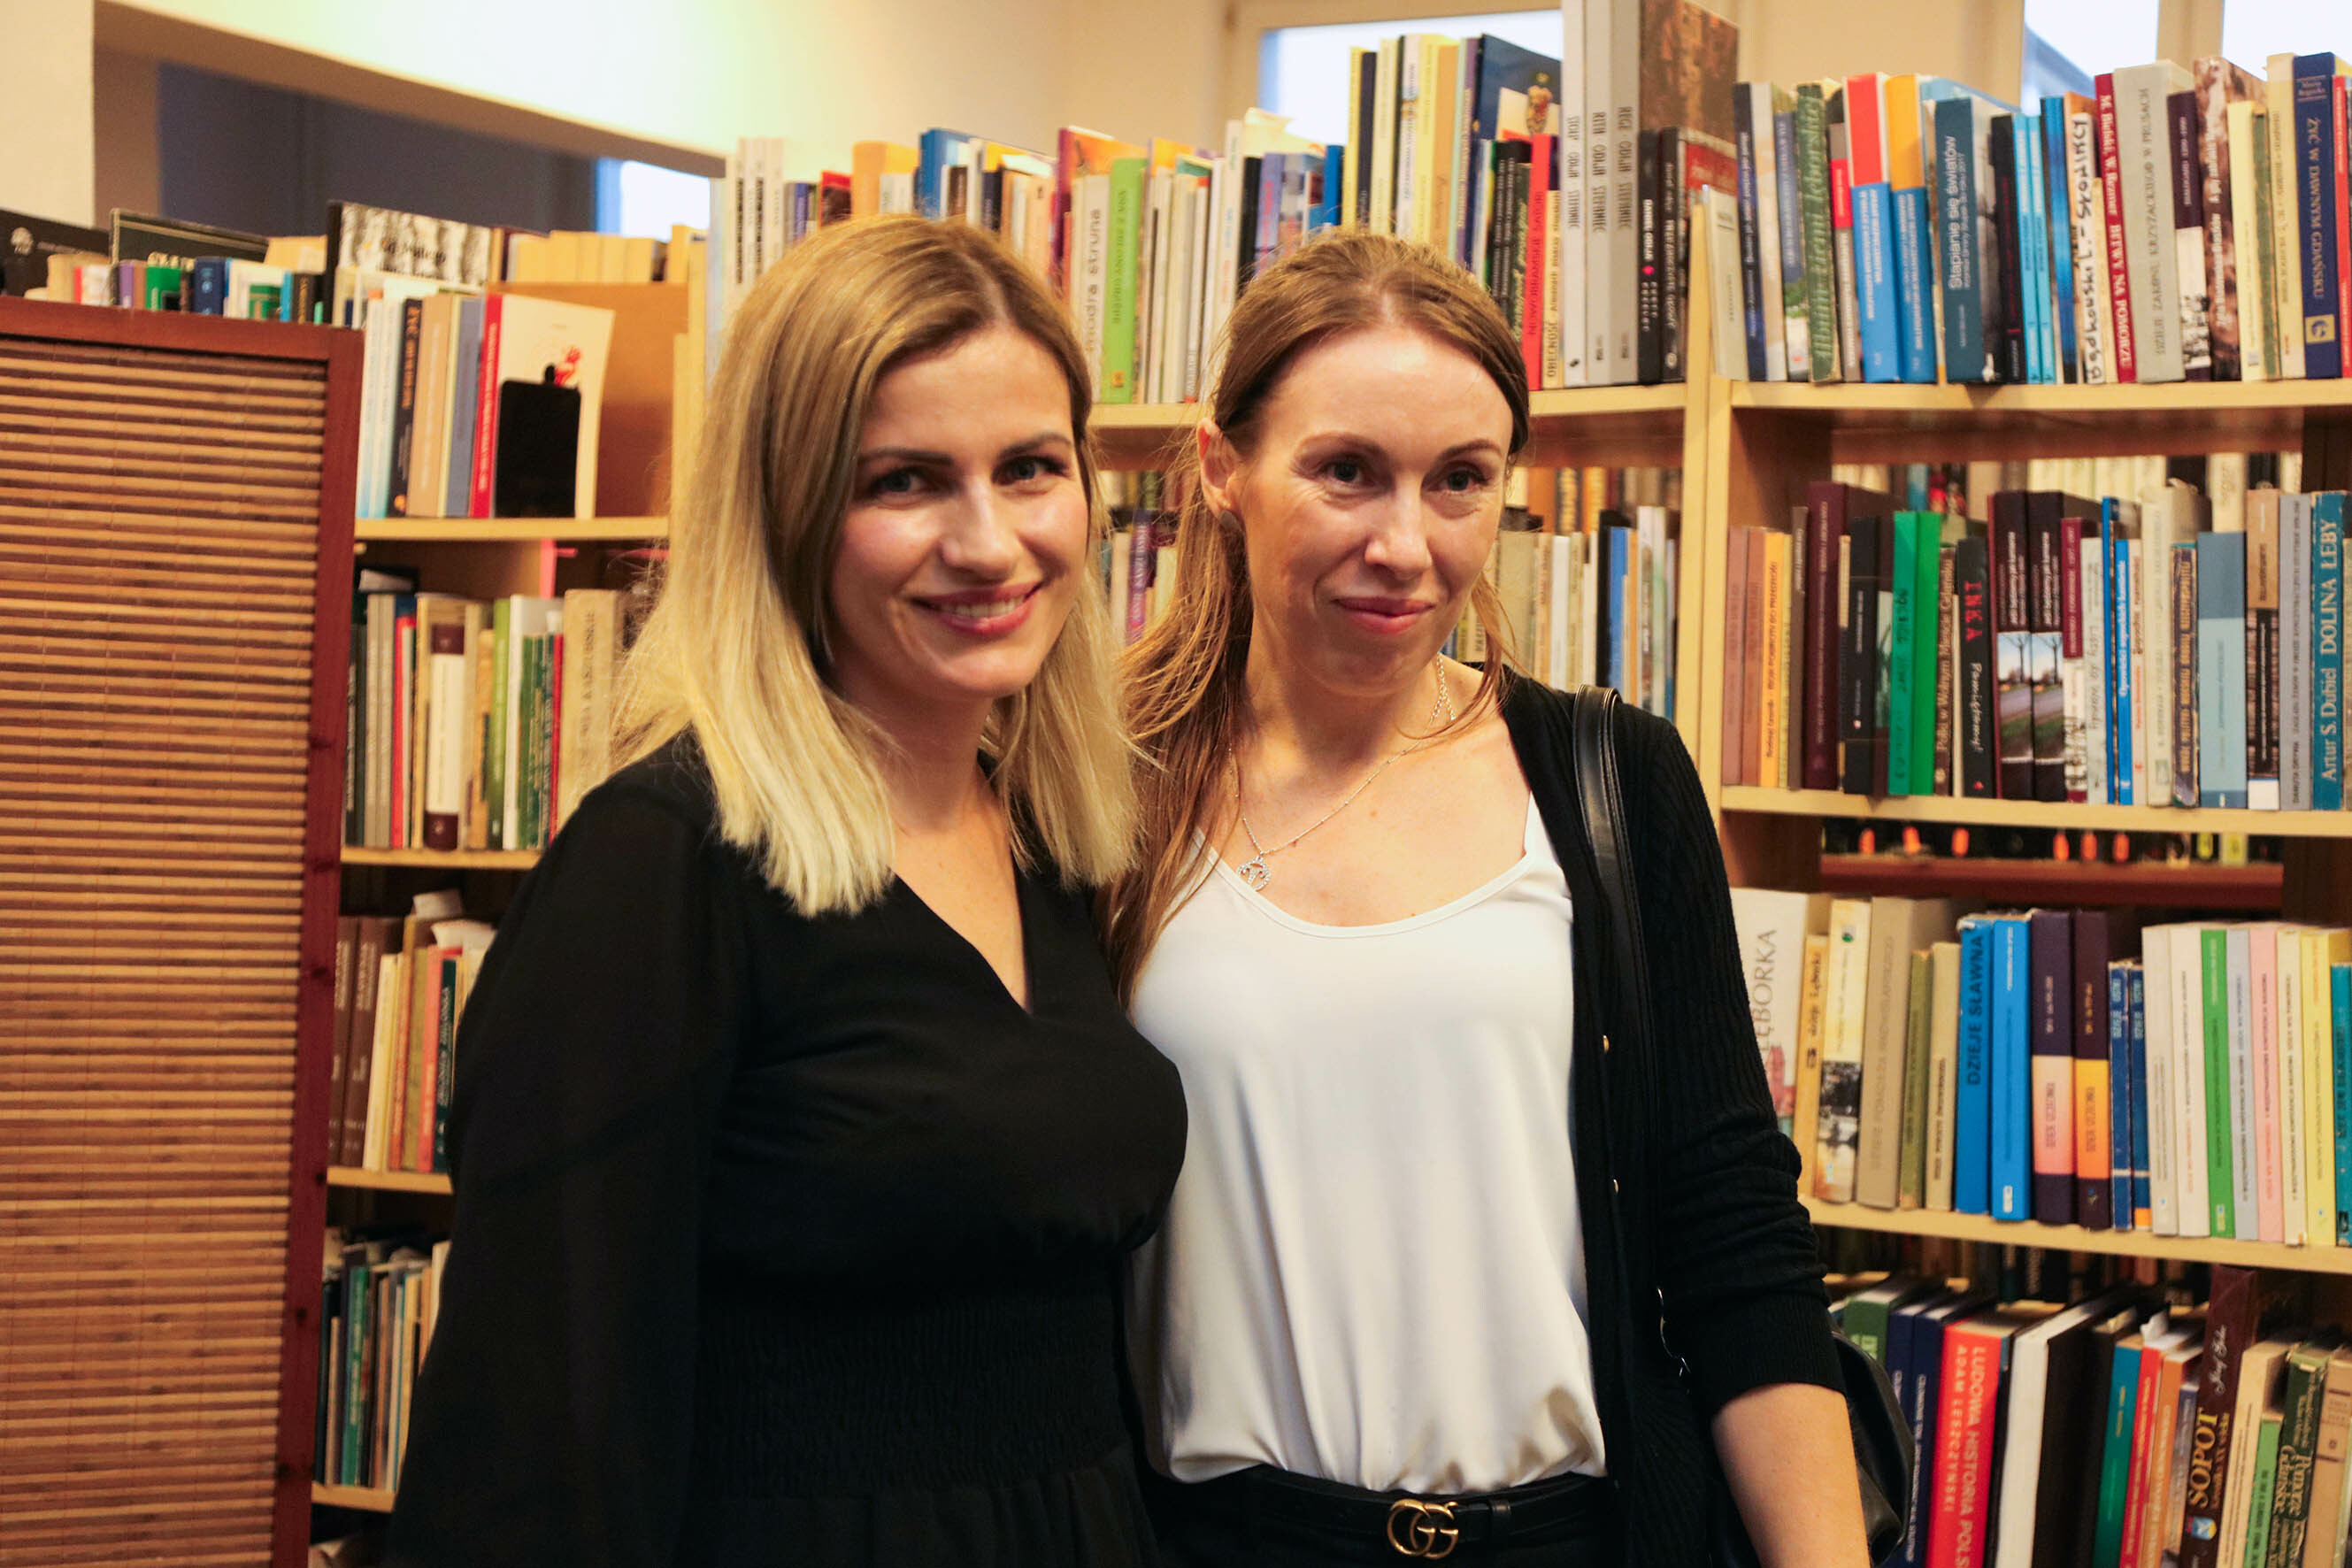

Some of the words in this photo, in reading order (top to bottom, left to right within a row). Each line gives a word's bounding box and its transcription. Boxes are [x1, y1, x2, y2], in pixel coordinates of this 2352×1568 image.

[2099, 95, 2112, 110] M.
[2305, 118, 2322, 145] ŻYĆ
[2308, 148, 2320, 161] W
[1944, 135, 1959, 196] światów
[2104, 155, 2116, 172] W.
[1643, 199, 1654, 231] DANIEL
[1948, 197, 1962, 219] się
[2307, 165, 2324, 228] DAWNYM
[1643, 232, 1654, 261] ODIJA
[1948, 222, 1964, 288] Stapianie
[2110, 224, 2125, 269] BITWY
[2309, 232, 2327, 300] GDAŃSKU
[2114, 274, 2125, 295] NA
[2116, 300, 2133, 369] POMORZU
[2318, 518, 2338, 570] ŁEBY
[1964, 580, 1984, 642] INKA
[2318, 576, 2338, 655] DOLINA
[1938, 658, 1954, 706] Wolnym
[2319, 667, 2338, 718] Dubiel
[2319, 720, 2338, 735] S.
[2320, 738, 2338, 780] Artur
[1968, 933, 1986, 1018] SŁAWNA
[1965, 1021, 1984, 1085] DZIEJE
[1953, 1344, 1969, 1393] ADAM
[1966, 1345, 1987, 1426] LUDOWA
[1958, 1430, 1981, 1516] HISTORIA
[2186, 1406, 2218, 1510] SOPOT
